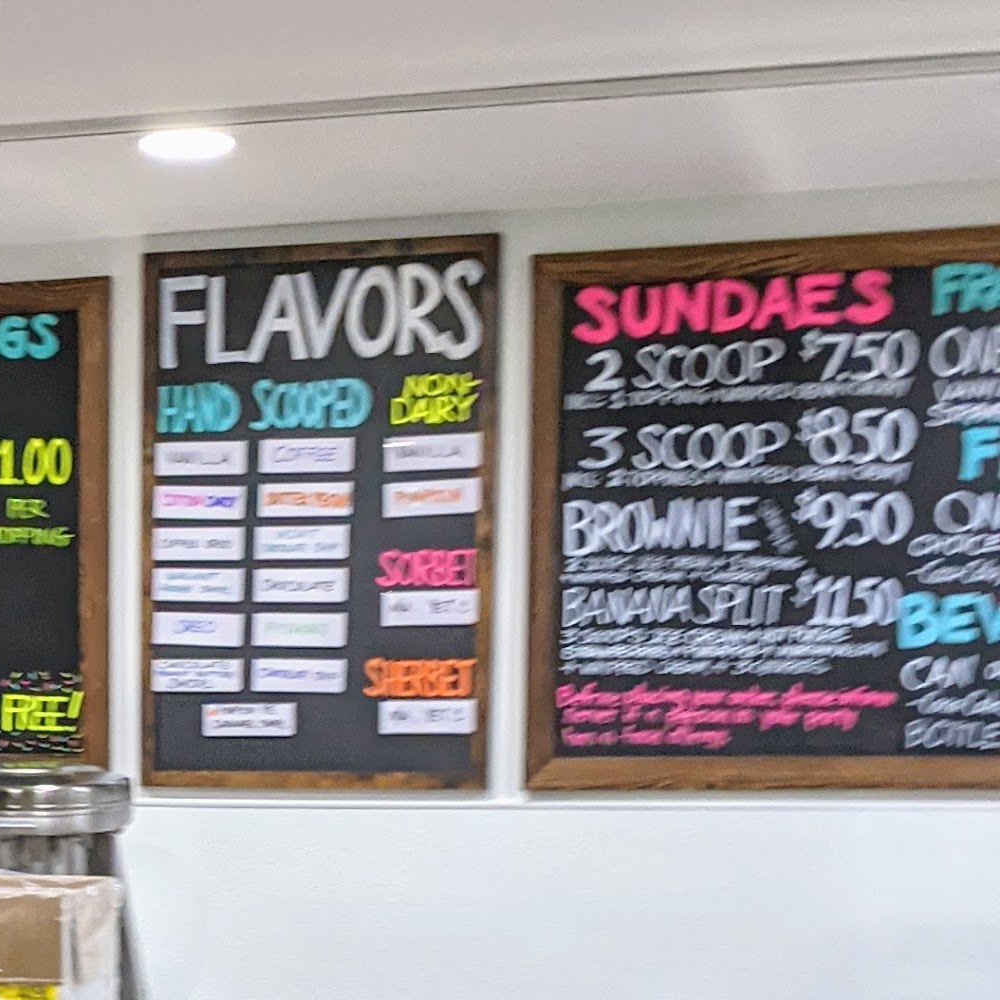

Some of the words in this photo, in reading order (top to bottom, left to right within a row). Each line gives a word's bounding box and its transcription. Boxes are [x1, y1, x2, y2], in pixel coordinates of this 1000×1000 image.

[159, 259, 485, 369] FLAVORS
[571, 269, 895, 345] SUNDAES
[583, 349, 626, 392] 2
[630, 338, 787, 389] SCOOP
[157, 382, 241, 433] HAND
[249, 378, 373, 430] SCOOPED
[577, 426, 629, 469] 3
[630, 421, 791, 470] SCOOP
[562, 496, 760, 557] BROWNIE
[375, 549, 477, 588] SORBET
[562, 583, 692, 627] BANANA
[692, 583, 791, 627] SPLIT
[363, 657, 478, 698] SHERBET
